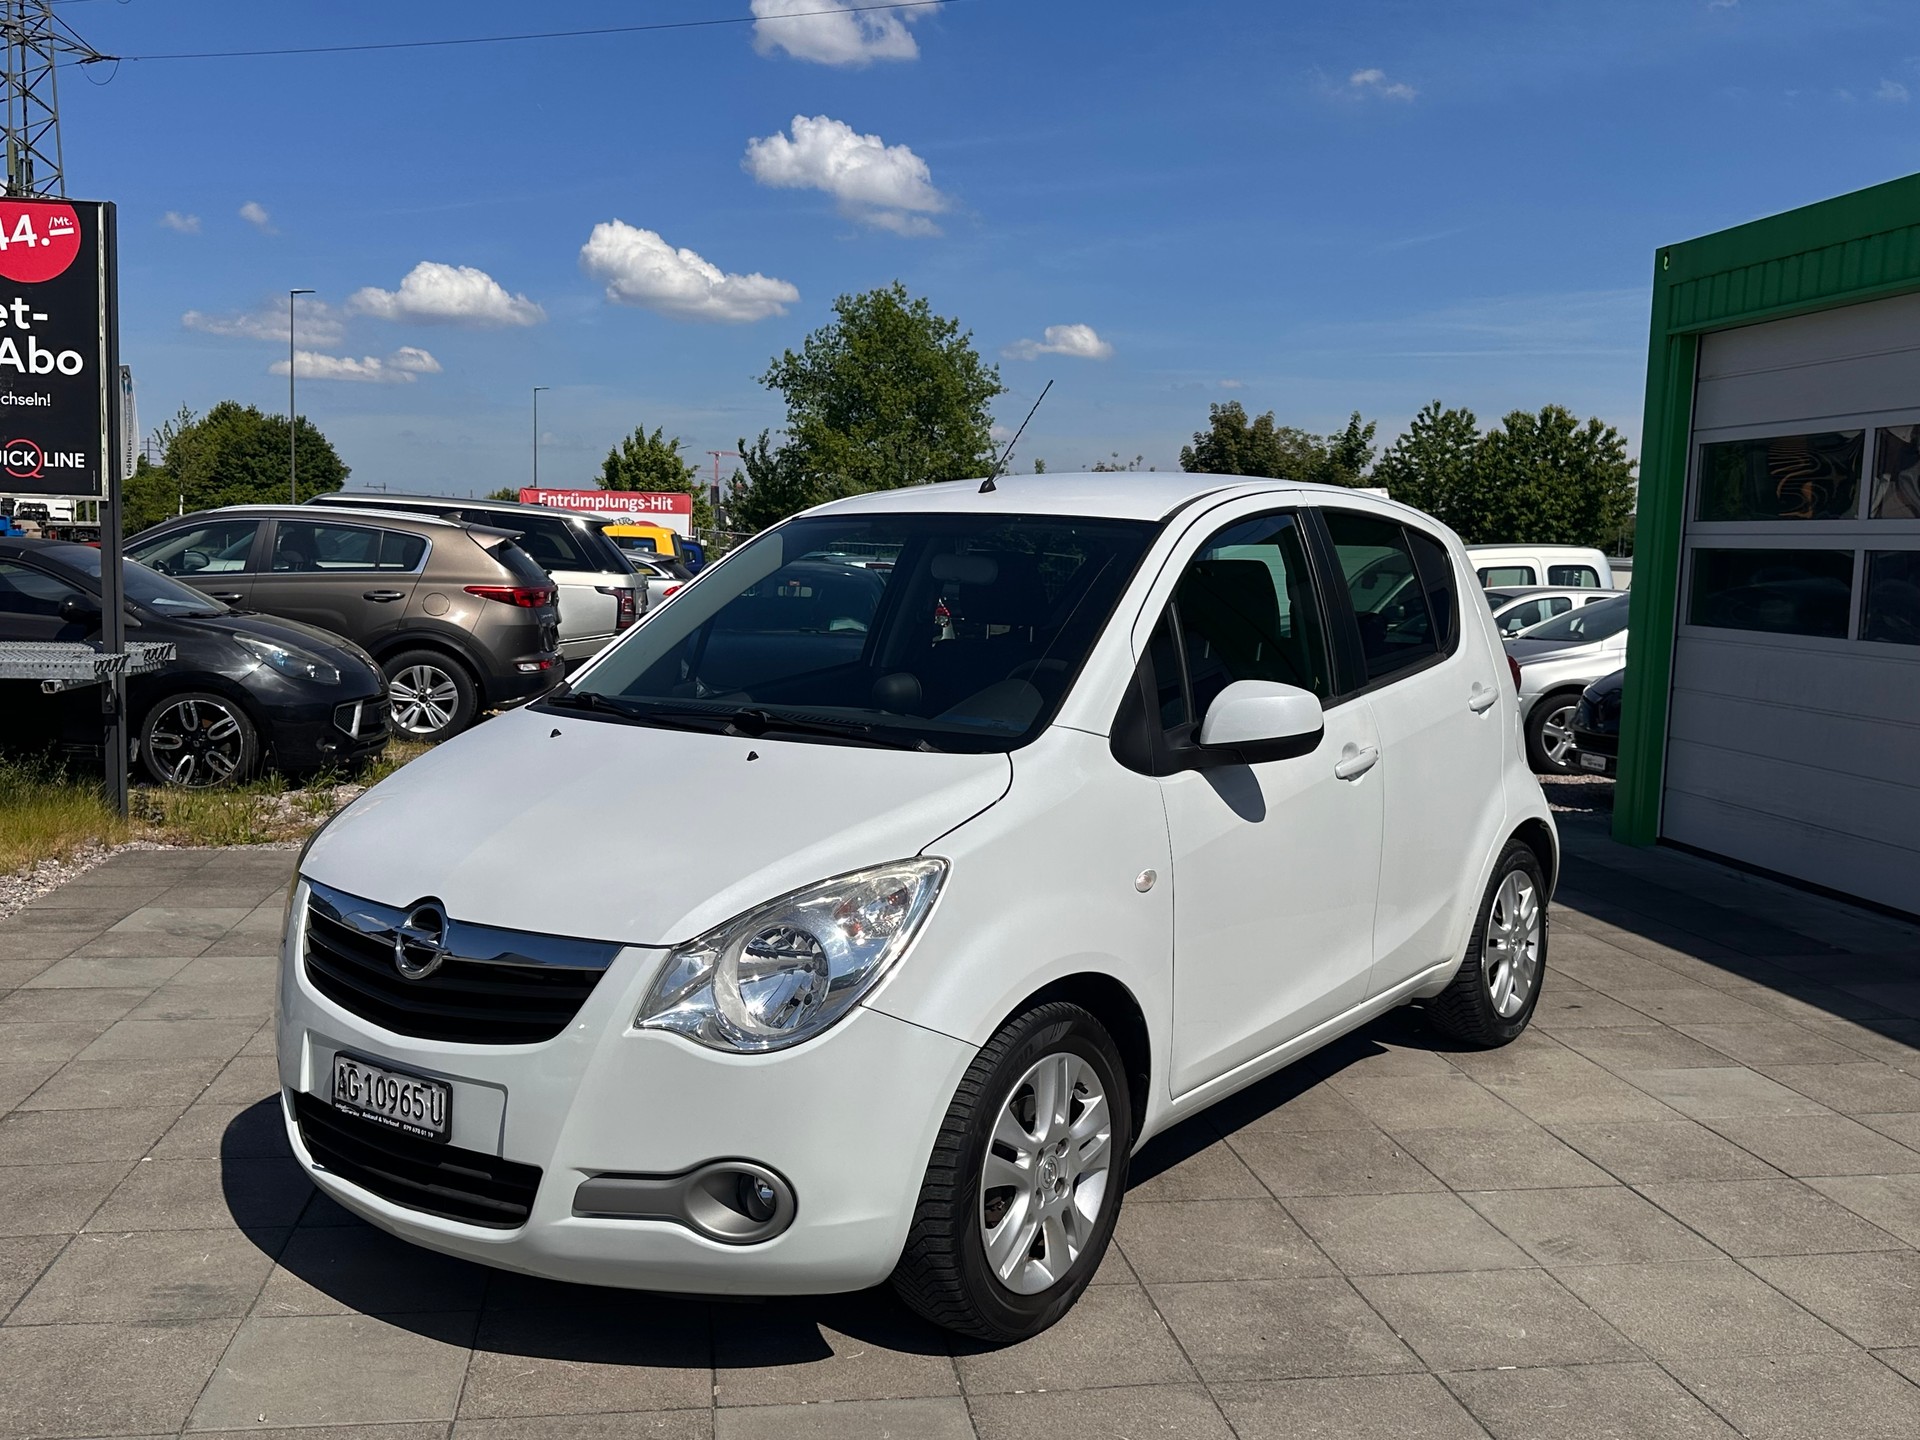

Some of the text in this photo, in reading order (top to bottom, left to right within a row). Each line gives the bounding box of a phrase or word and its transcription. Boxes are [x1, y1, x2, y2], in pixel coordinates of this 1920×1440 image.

[0, 335, 84, 376] Abo
[0, 390, 51, 407] chseln!
[538, 492, 673, 512] Entrümplungs-Hit
